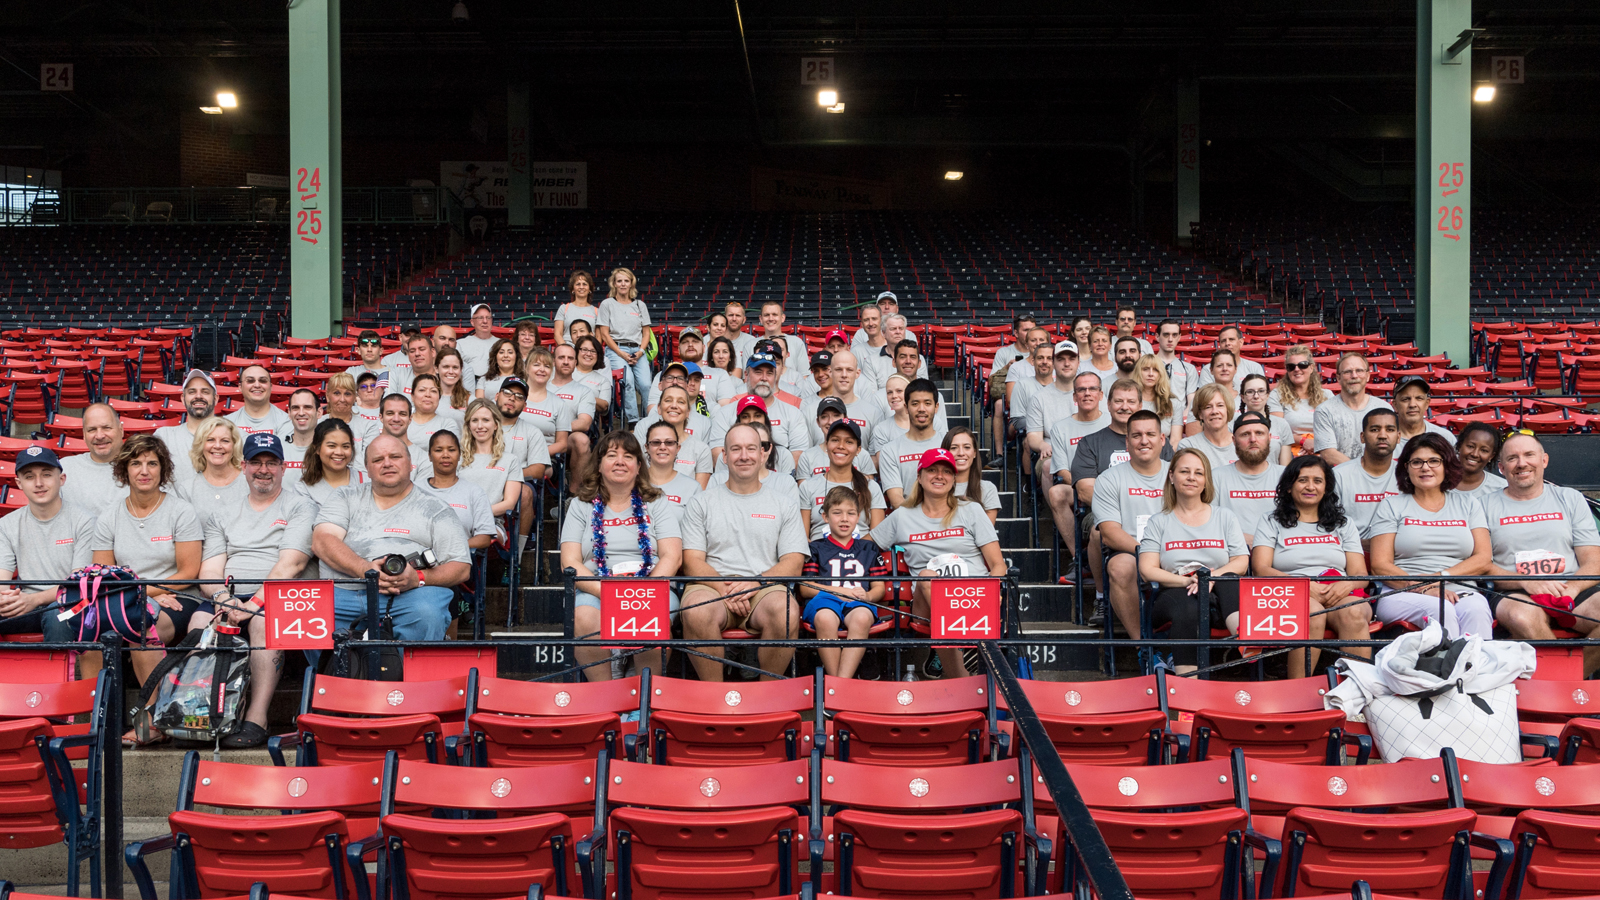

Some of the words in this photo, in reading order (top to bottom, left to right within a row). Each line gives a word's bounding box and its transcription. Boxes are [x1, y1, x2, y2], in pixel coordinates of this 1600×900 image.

[46, 67, 69, 87] 24
[807, 61, 829, 80] 25
[1497, 60, 1519, 80] 26
[511, 152, 526, 167] 25
[297, 168, 321, 192] 24
[1439, 162, 1464, 187] 25
[486, 192, 505, 206] The
[297, 210, 322, 235] 25
[1438, 206, 1463, 231] 26
[526, 408, 550, 417] SYSTEMS
[1522, 513, 1560, 523] SYSTEMS
[929, 529, 962, 540] SYSTEMS
[1186, 540, 1222, 549] SYSTEMS
[829, 559, 865, 590] 12
[1520, 558, 1562, 575] 3167
[278, 588, 321, 599] LOGE
[616, 588, 656, 599] LOGE
[945, 587, 986, 597] LOGE
[1252, 586, 1295, 596] LOGE
[284, 601, 316, 611] BOX
[620, 600, 650, 610] BOX
[950, 599, 981, 609] BOX
[1257, 598, 1290, 609] BOX
[274, 617, 328, 639] 143
[611, 616, 661, 637] 144
[941, 615, 992, 635] 144
[1246, 614, 1299, 637] 145
[535, 646, 564, 663] BB
